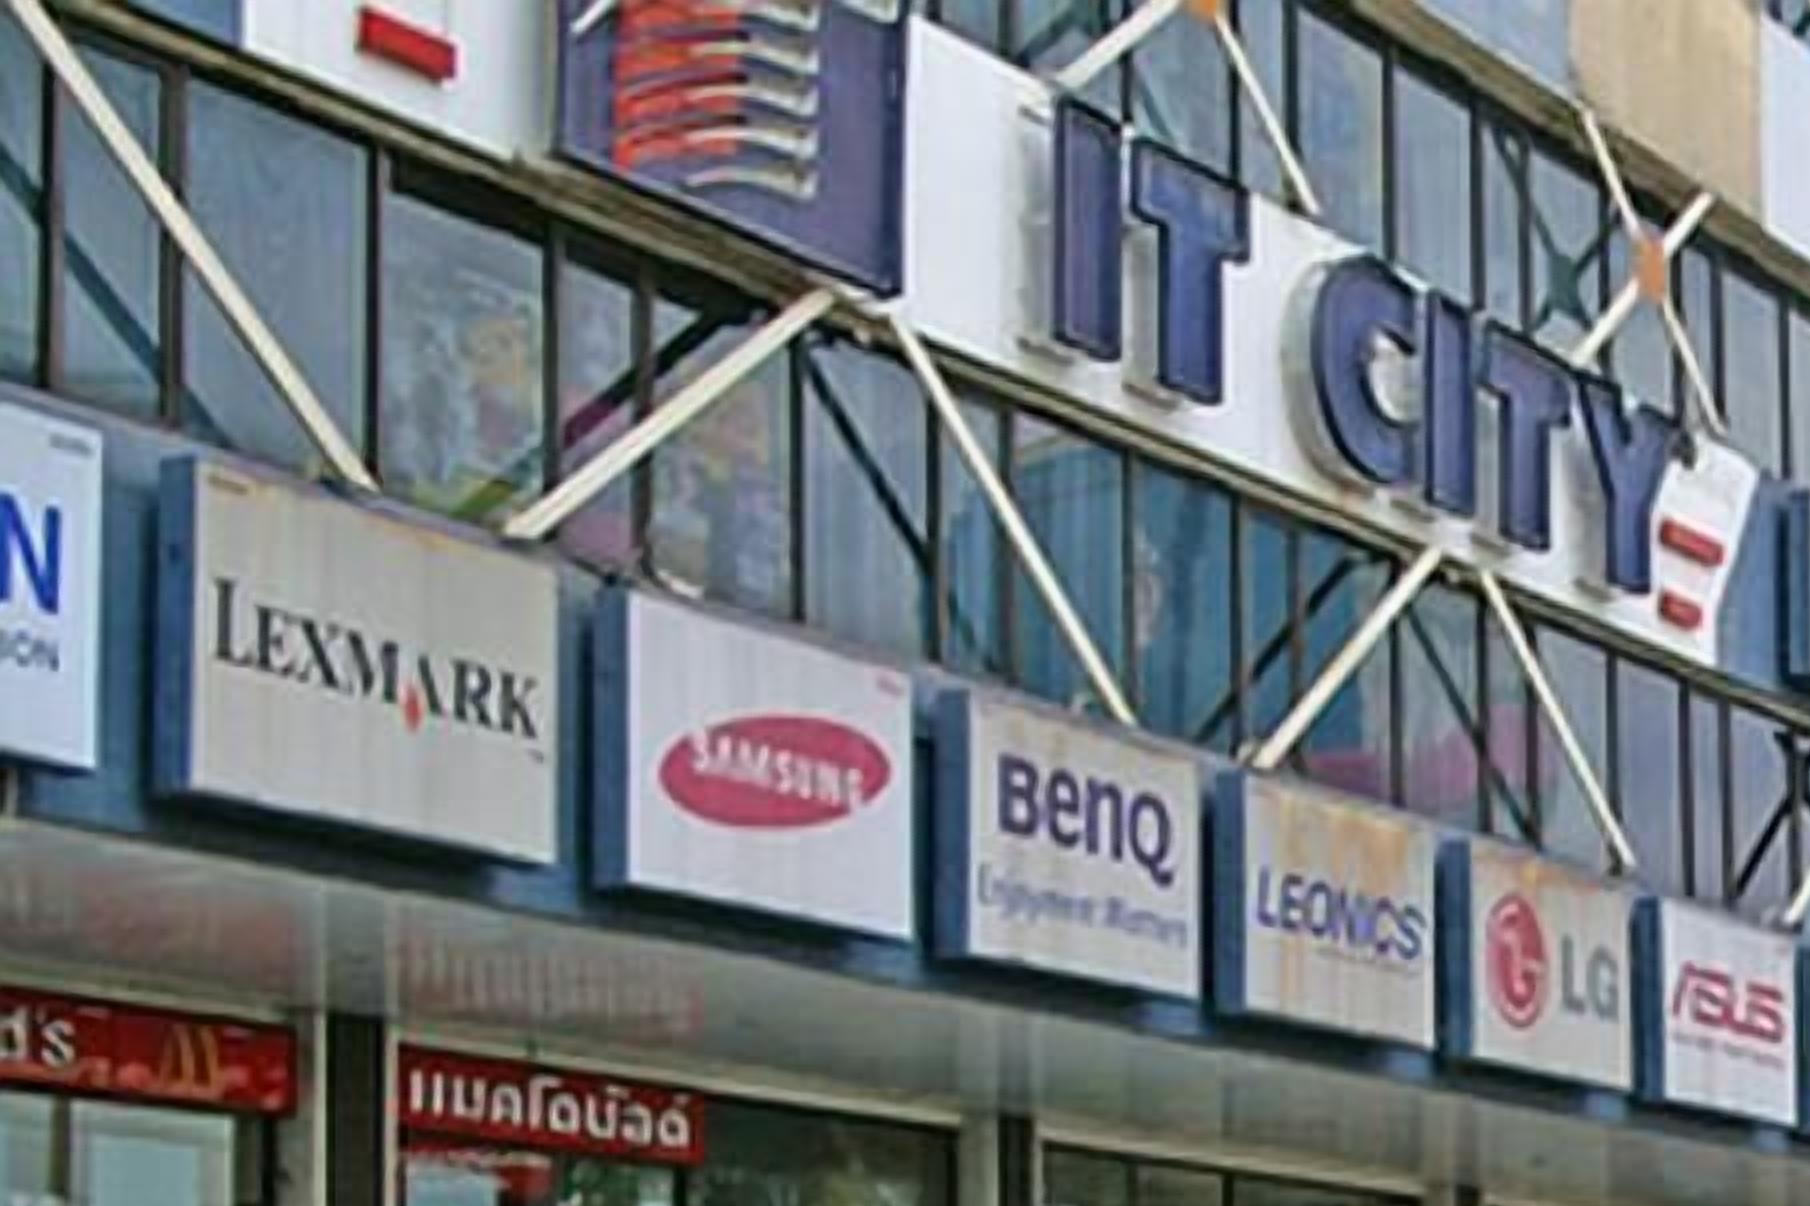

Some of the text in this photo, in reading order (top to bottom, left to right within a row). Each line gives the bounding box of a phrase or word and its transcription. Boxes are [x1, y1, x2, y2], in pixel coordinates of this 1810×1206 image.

[1050, 93, 1682, 595] IT CITY
[212, 575, 541, 742] LEXMARK
[690, 730, 866, 812] SAMSUNG
[997, 752, 1174, 888] BenQ
[1255, 863, 1427, 963] LEONICS
[1560, 934, 1620, 1024] LG
[1672, 960, 1784, 1045] ASUS
